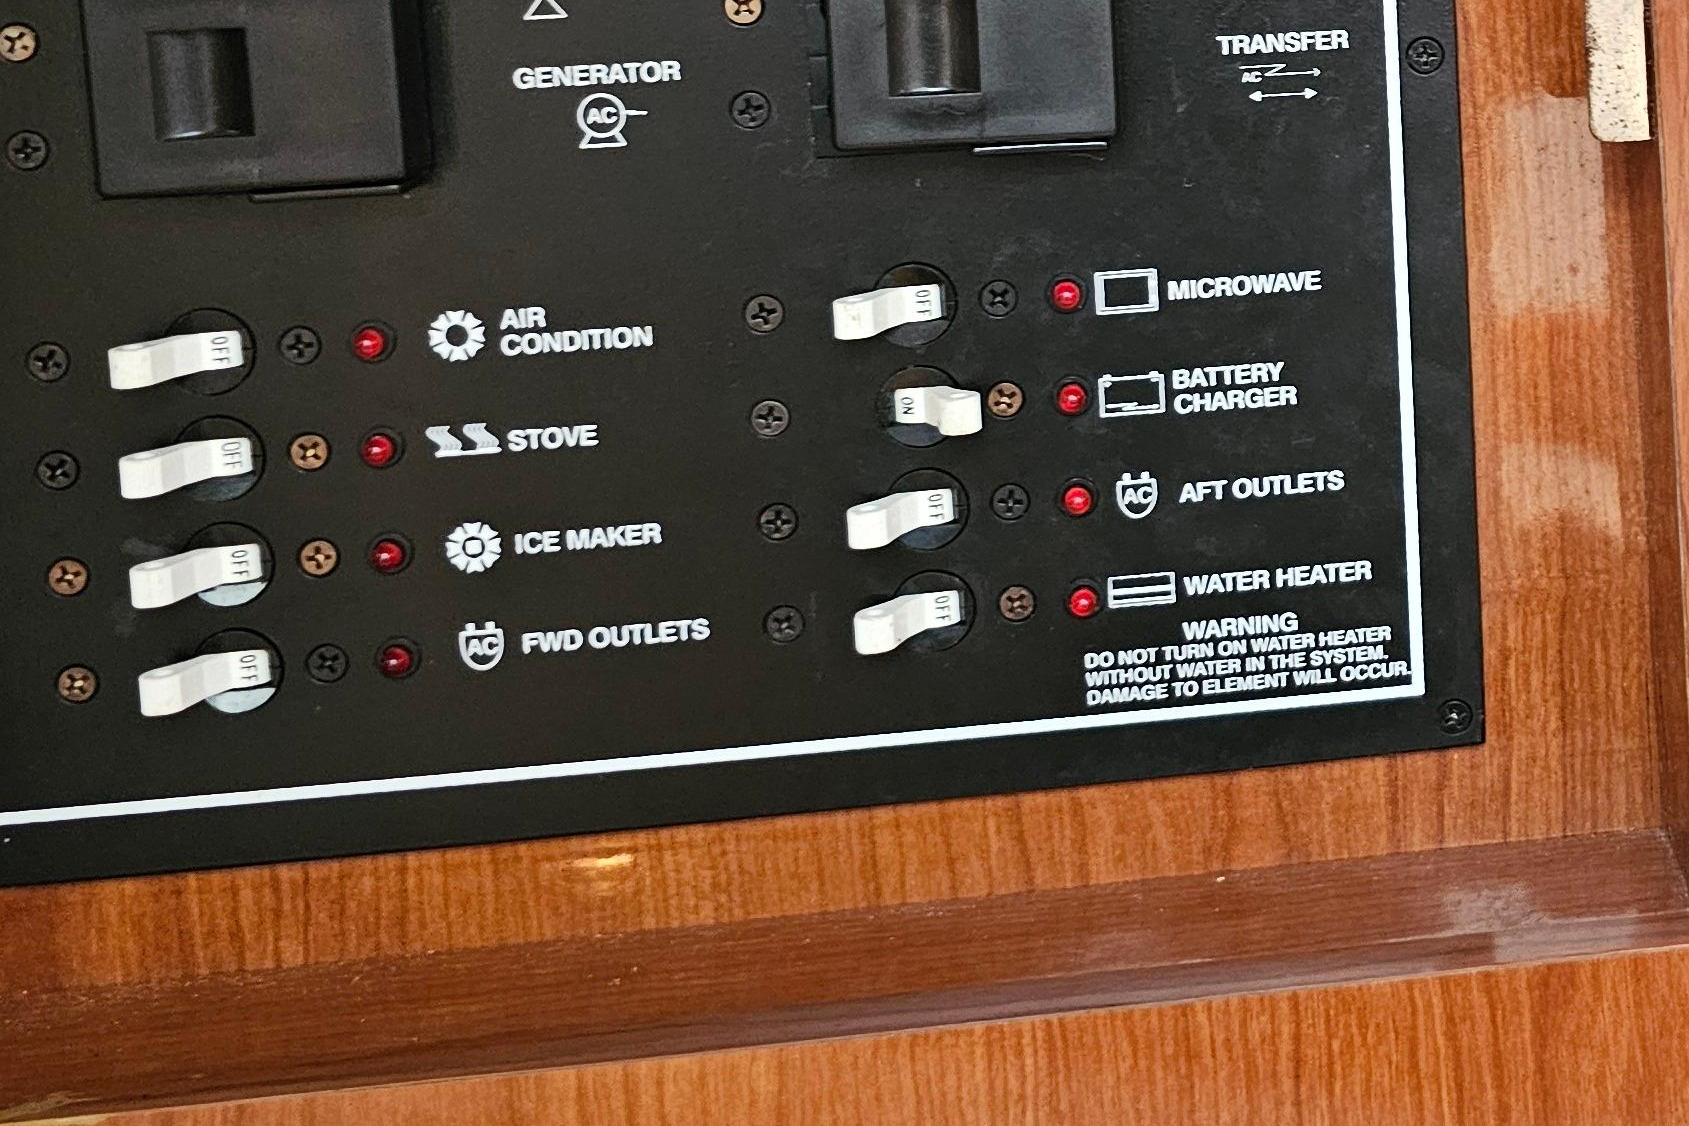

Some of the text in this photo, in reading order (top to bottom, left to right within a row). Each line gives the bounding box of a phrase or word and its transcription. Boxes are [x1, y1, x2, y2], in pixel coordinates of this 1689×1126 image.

[1215, 29, 1350, 55] TRANSFER
[512, 59, 682, 90] GENERATOR
[1167, 270, 1322, 301] MICROWAVE
[916, 289, 933, 317] OFF
[500, 306, 546, 330] AIR
[210, 336, 231, 365] OFF
[500, 325, 653, 357] CONDITION
[1172, 361, 1285, 389] BATTERY
[900, 397, 915, 416] ON
[1173, 386, 1298, 415] CHARGER
[507, 424, 599, 452] STOVE
[220, 441, 243, 469] OFF
[1178, 469, 1345, 503] AFT OUTLETS
[514, 522, 662, 555] ICE MAKER
[230, 549, 250, 578] OFF
[1183, 560, 1372, 596] WATER HEATER
[521, 617, 711, 655] FWD OUTLETS
[1182, 612, 1299, 641] WARNING
[1084, 626, 1391, 669] DO NOT TURN ON WATER HEATER
[1085, 645, 1388, 687] WITHOUT WATER IN THE SYSTEM.
[1086, 660, 1412, 706] DAMAGE TO ELEMENT WILL OCCUR.
